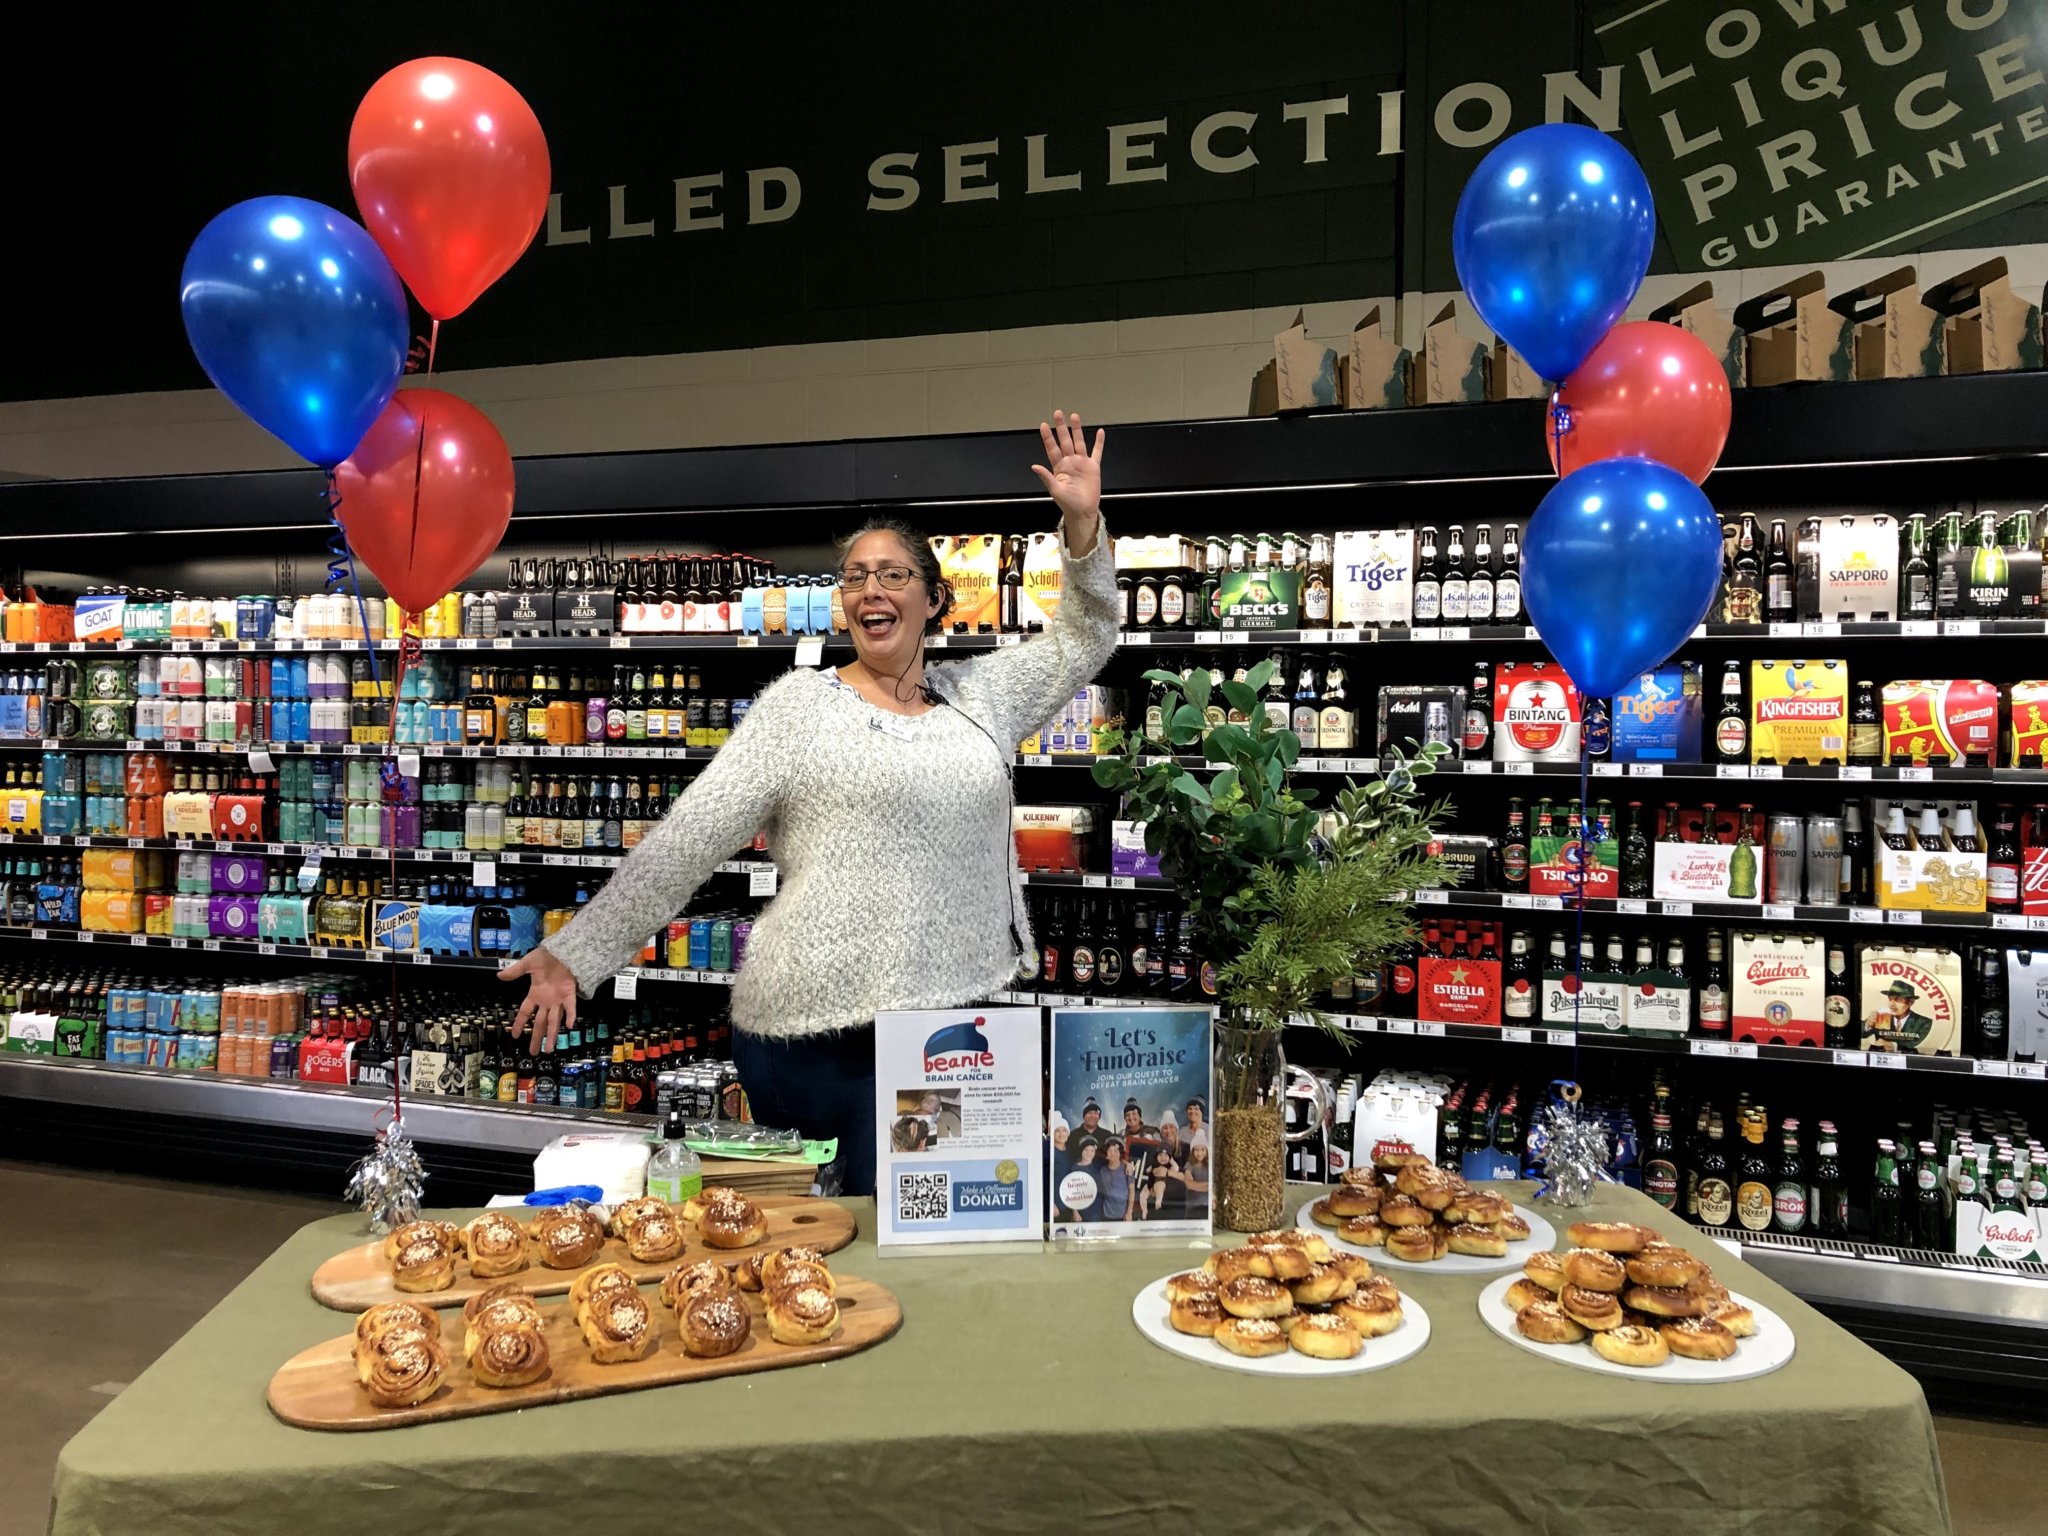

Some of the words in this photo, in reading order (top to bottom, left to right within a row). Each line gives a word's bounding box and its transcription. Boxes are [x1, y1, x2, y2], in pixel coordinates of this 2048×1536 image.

[1680, 33, 2046, 225] PRICE
[865, 63, 1625, 212] SELECTION
[1701, 104, 2048, 268] GUARANTE
[1346, 561, 1408, 591] Tiger
[1829, 569, 1889, 582] SAPPORO
[1307, 592, 1328, 604] Tiger
[1970, 587, 2009, 598] KIRIN
[513, 610, 537, 618] HEADS
[571, 608, 597, 617] HEADS
[1229, 601, 1289, 616] BECK'S
[85, 609, 113, 628] GOAT
[124, 610, 164, 628] ATOMIC
[1389, 701, 1421, 714] Asahi
[1617, 694, 1681, 724] Tiger
[1760, 699, 1841, 717] KINGFISHER
[1509, 709, 1567, 721] BINTANG
[1772, 725, 1829, 735] PREMIUM
[1022, 813, 1061, 822] KILKENNY
[1688, 861, 1717, 872] Lucky
[1680, 871, 1720, 881] Buddha
[43, 899, 63, 911] WILD
[47, 909, 61, 918] YAK
[373, 916, 397, 935] BLUE
[398, 908, 420, 925] MOON
[1746, 960, 1810, 982] Budvar
[1433, 984, 1485, 996] ESTRELLA
[1753, 988, 1778, 996] CZECH
[1779, 989, 1804, 997] LAGER
[1870, 962, 1951, 1022] MORETTI
[1439, 1002, 1479, 1010] BARCELONA
[1550, 990, 1587, 1013] Pilsner
[1585, 992, 1619, 1007] Urquell
[1656, 996, 1680, 1008] Urquell
[67, 1034, 80, 1043] FAT
[1104, 1027, 1156, 1048] Let's
[67, 1042, 82, 1054] YAK
[923, 1050, 995, 1073] beanie
[1080, 1046, 1187, 1072] Fundraise
[359, 1066, 387, 1084] BLACK
[925, 1074, 954, 1083] BRAIN
[956, 1073, 994, 1082] CANCER
[1096, 1074, 1115, 1082] JOIN
[1116, 1073, 1133, 1081] OUR
[1134, 1070, 1160, 1080] QUEST
[1162, 1069, 1174, 1077] TO
[415, 1079, 436, 1090] SPADES
[1090, 1080, 1120, 1090] DEFEAT
[1122, 1078, 1146, 1088] BRAIN
[1148, 1075, 1180, 1086] CANCER
[1379, 1145, 1410, 1154] STELLA
[961, 1186, 978, 1194] Make
[984, 1184, 1017, 1194] Difference!
[960, 1193, 1017, 1207] DONATE
[1701, 1200, 1728, 1211] Kozel
[1741, 1205, 1768, 1217] Kozel
[1774, 1201, 1804, 1212] BROK
[1984, 1224, 2035, 1244] Grolsch
